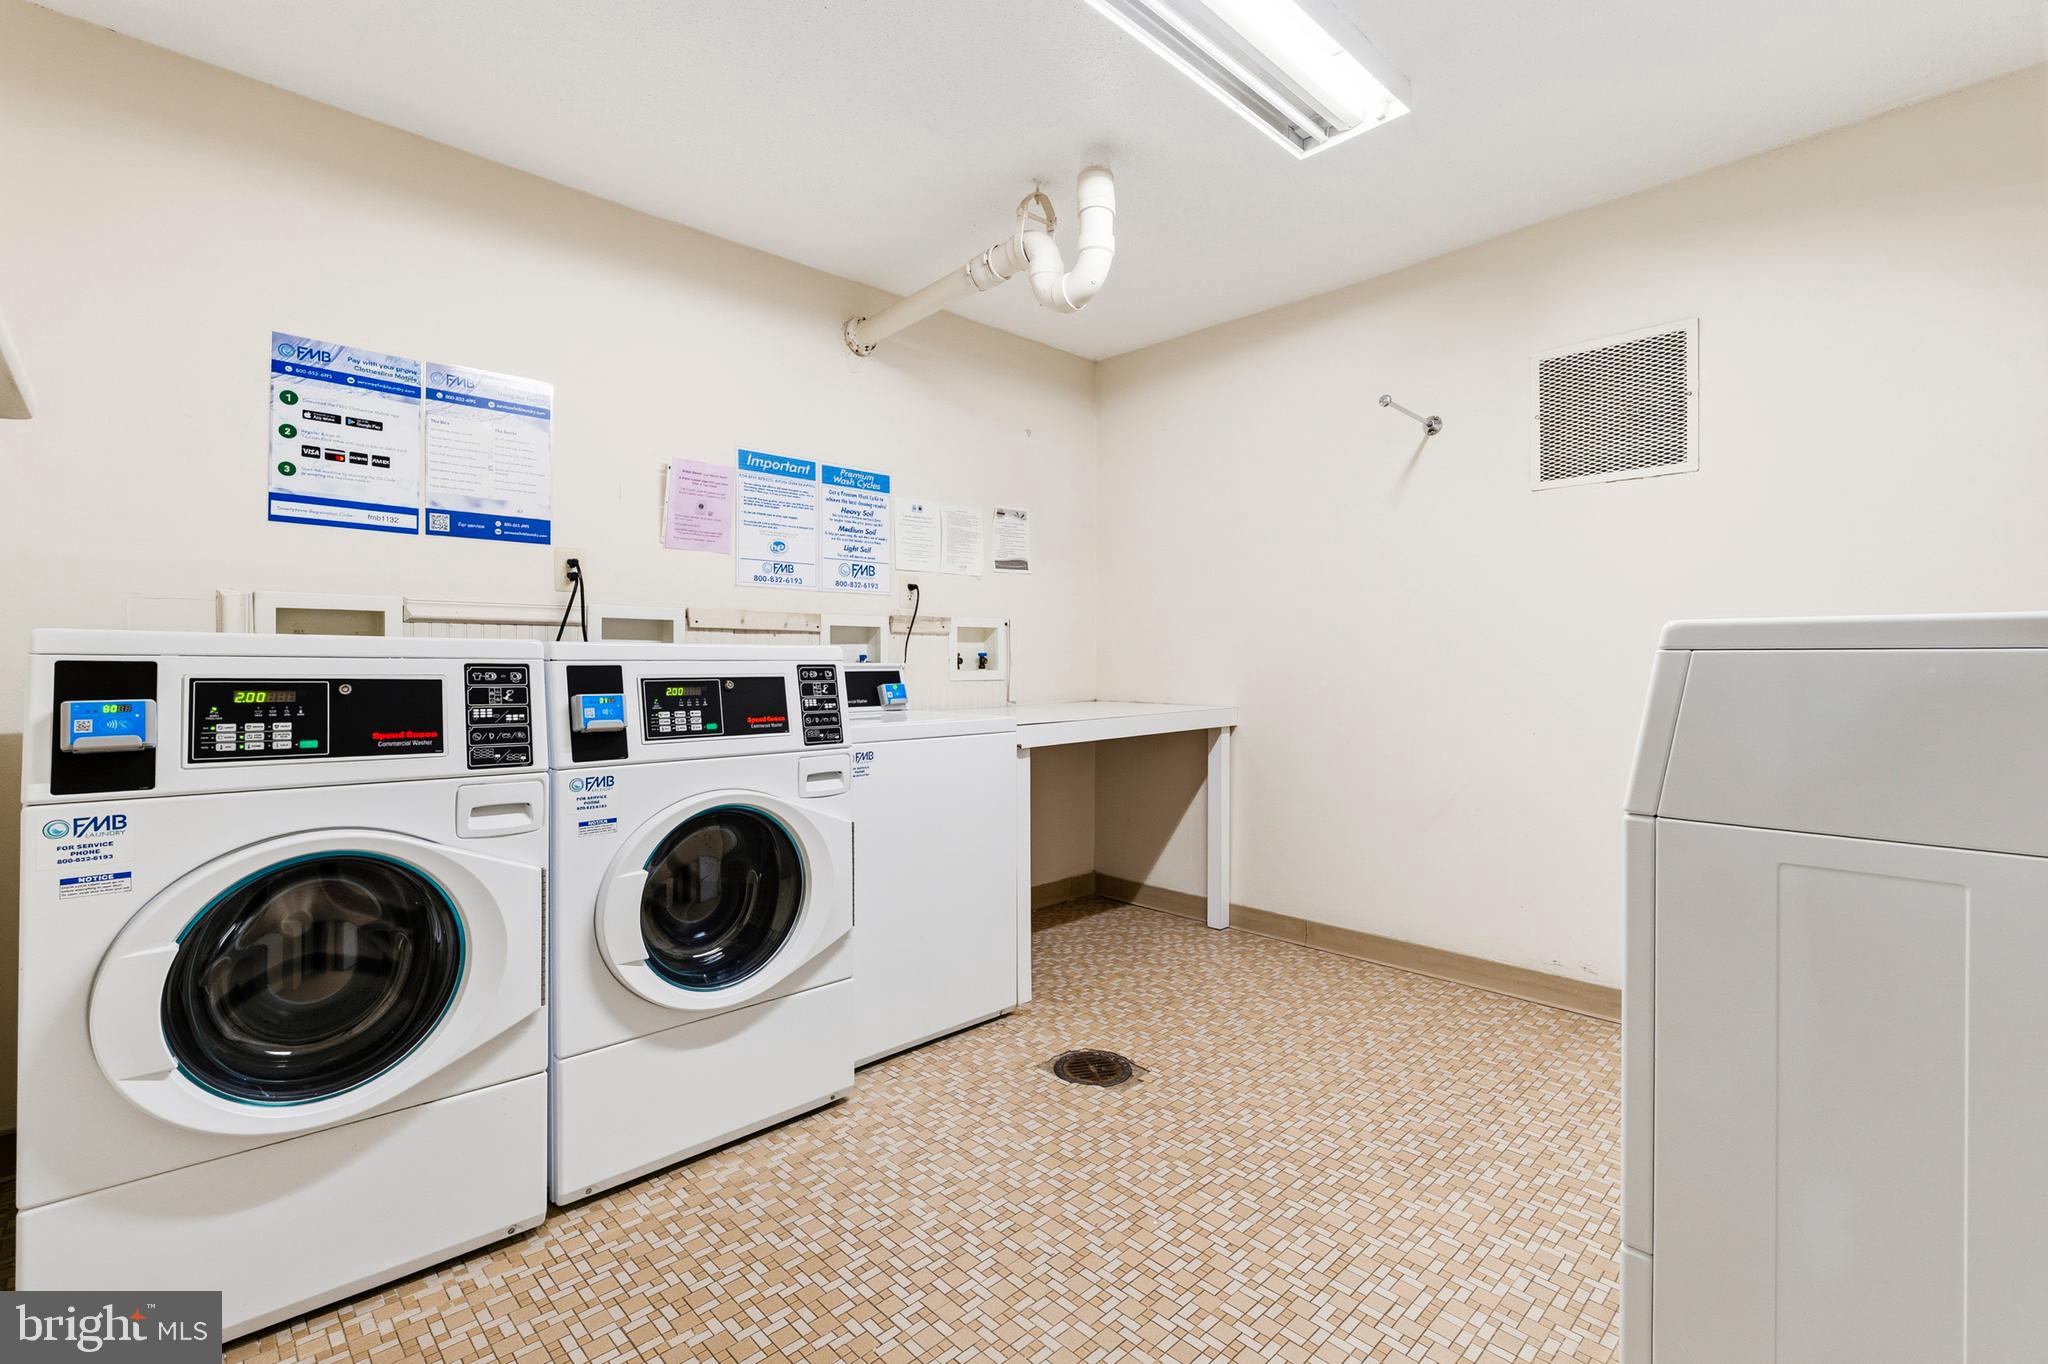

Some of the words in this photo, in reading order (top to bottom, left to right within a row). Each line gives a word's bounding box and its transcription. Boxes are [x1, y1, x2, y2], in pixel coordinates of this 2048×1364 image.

[297, 346, 331, 362] FMB
[347, 356, 360, 365] Pay
[362, 358, 378, 367] with
[379, 361, 395, 371] your
[446, 374, 475, 389] FMB
[284, 427, 291, 435] 2
[303, 447, 320, 456] VISA
[747, 453, 810, 475] Important
[841, 469, 874, 481] Premium
[833, 475, 855, 486] Wash
[857, 480, 881, 490] Cycles
[841, 507, 861, 517] Heavy
[862, 509, 875, 517] Soil
[367, 514, 399, 524] fmb1132
[838, 526, 864, 534] Medium
[865, 528, 877, 536] Soil
[843, 545, 859, 553] Light
[773, 563, 794, 575] FMB
[851, 563, 876, 579] FMB
[754, 574, 803, 585] 800-832-6193
[835, 580, 879, 589] 800-832-6193
[378, 740, 411, 748] Commercial
[856, 751, 874, 764] FMB
[585, 775, 615, 792] FMB
[73, 814, 127, 838] FMB
[76, 841, 114, 850] SERVICE
[78, 874, 114, 883] NOTICE
